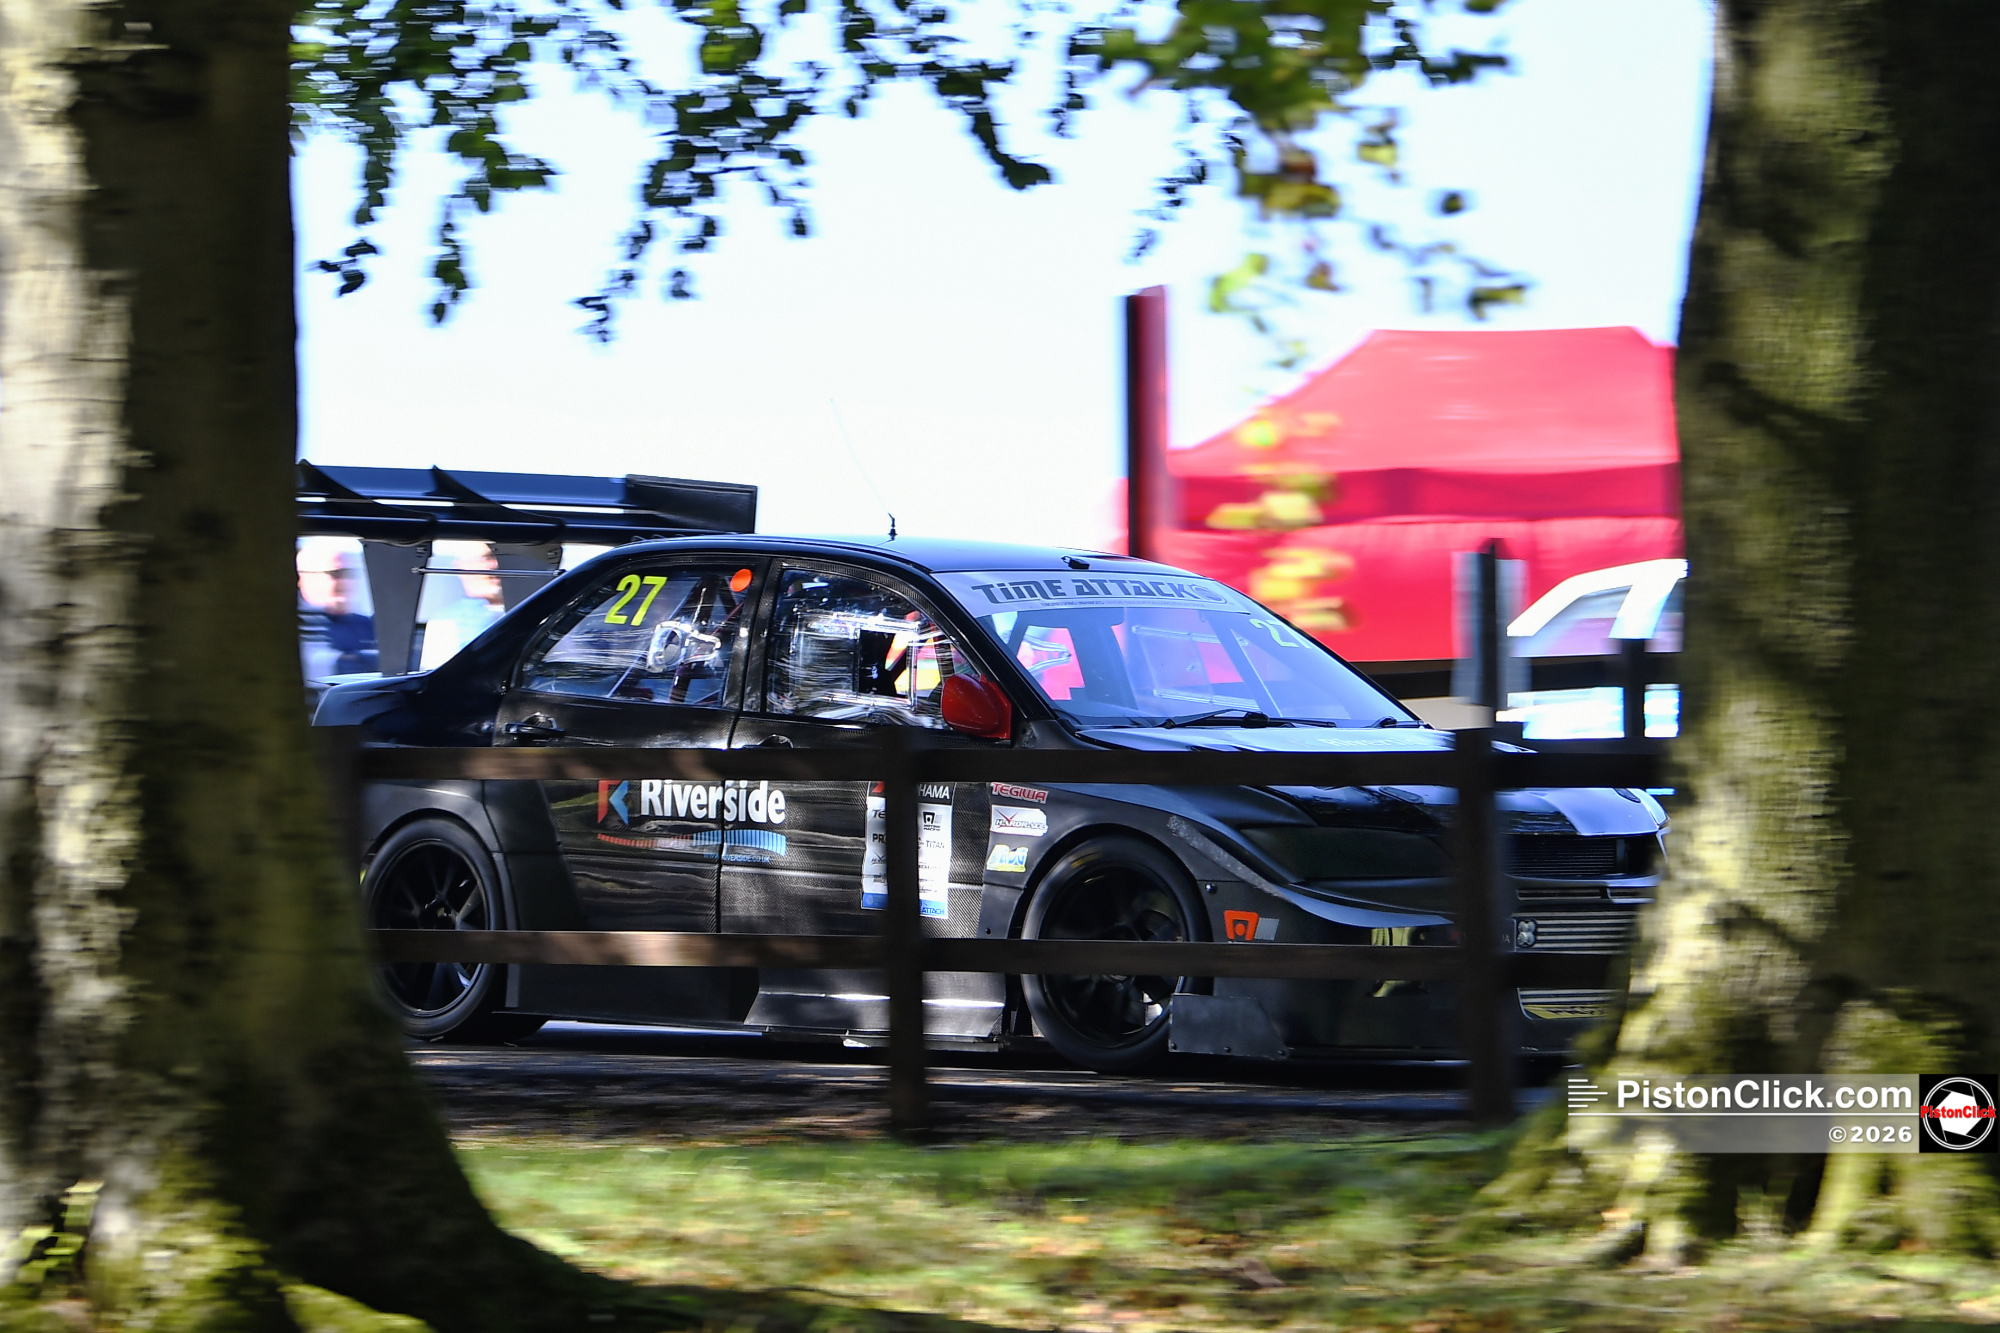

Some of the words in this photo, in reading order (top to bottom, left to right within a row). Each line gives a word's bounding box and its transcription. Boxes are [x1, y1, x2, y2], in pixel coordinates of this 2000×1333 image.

[604, 574, 668, 626] 27
[1071, 578, 1196, 600] ATTACK
[640, 779, 787, 825] Riverside
[918, 783, 950, 800] HAMA
[991, 782, 1047, 803] TEGIWA
